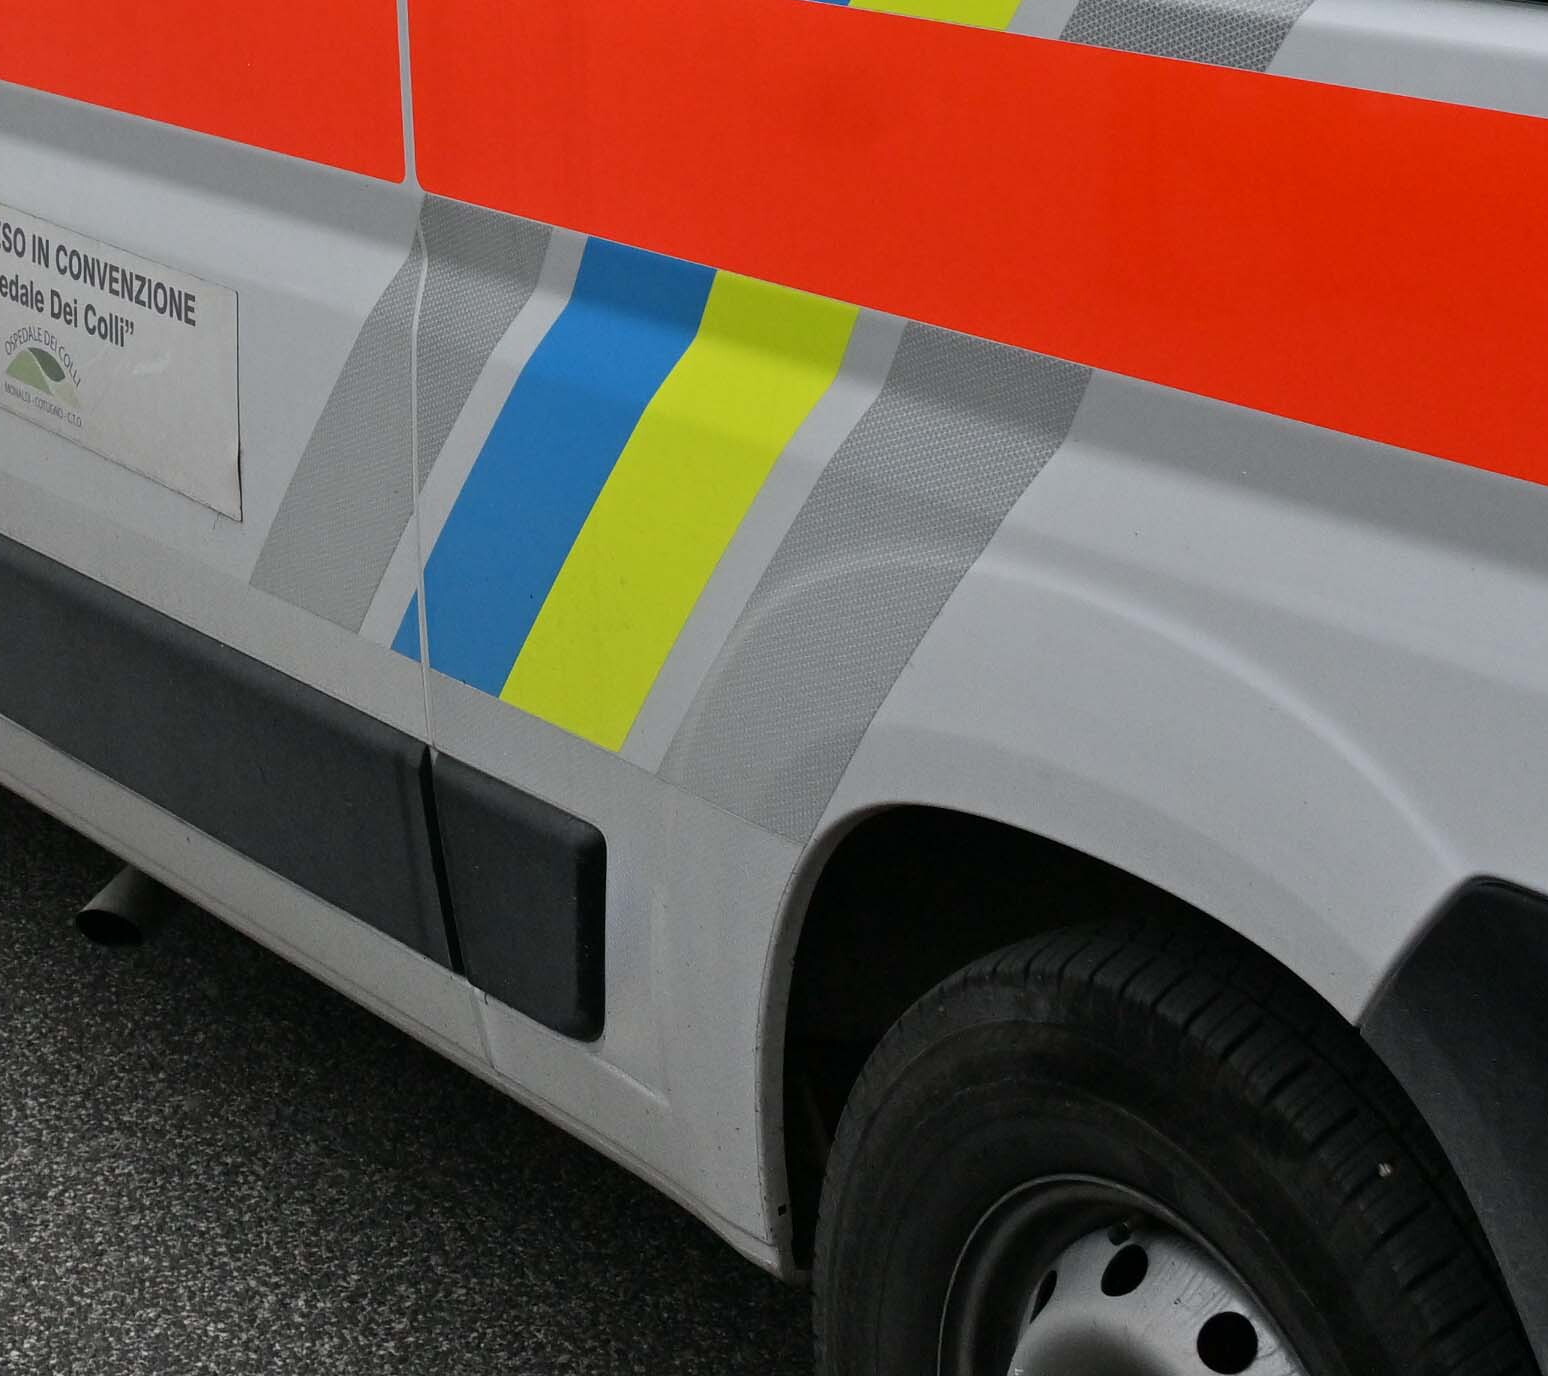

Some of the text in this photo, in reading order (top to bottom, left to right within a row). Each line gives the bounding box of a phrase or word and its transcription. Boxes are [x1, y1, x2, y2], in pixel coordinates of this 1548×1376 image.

[31, 233, 50, 269] IN
[55, 244, 197, 328] CONVENZIONE
[50, 288, 78, 329] Dei
[4, 326, 81, 388] OSPEDALE DEI COLLI
